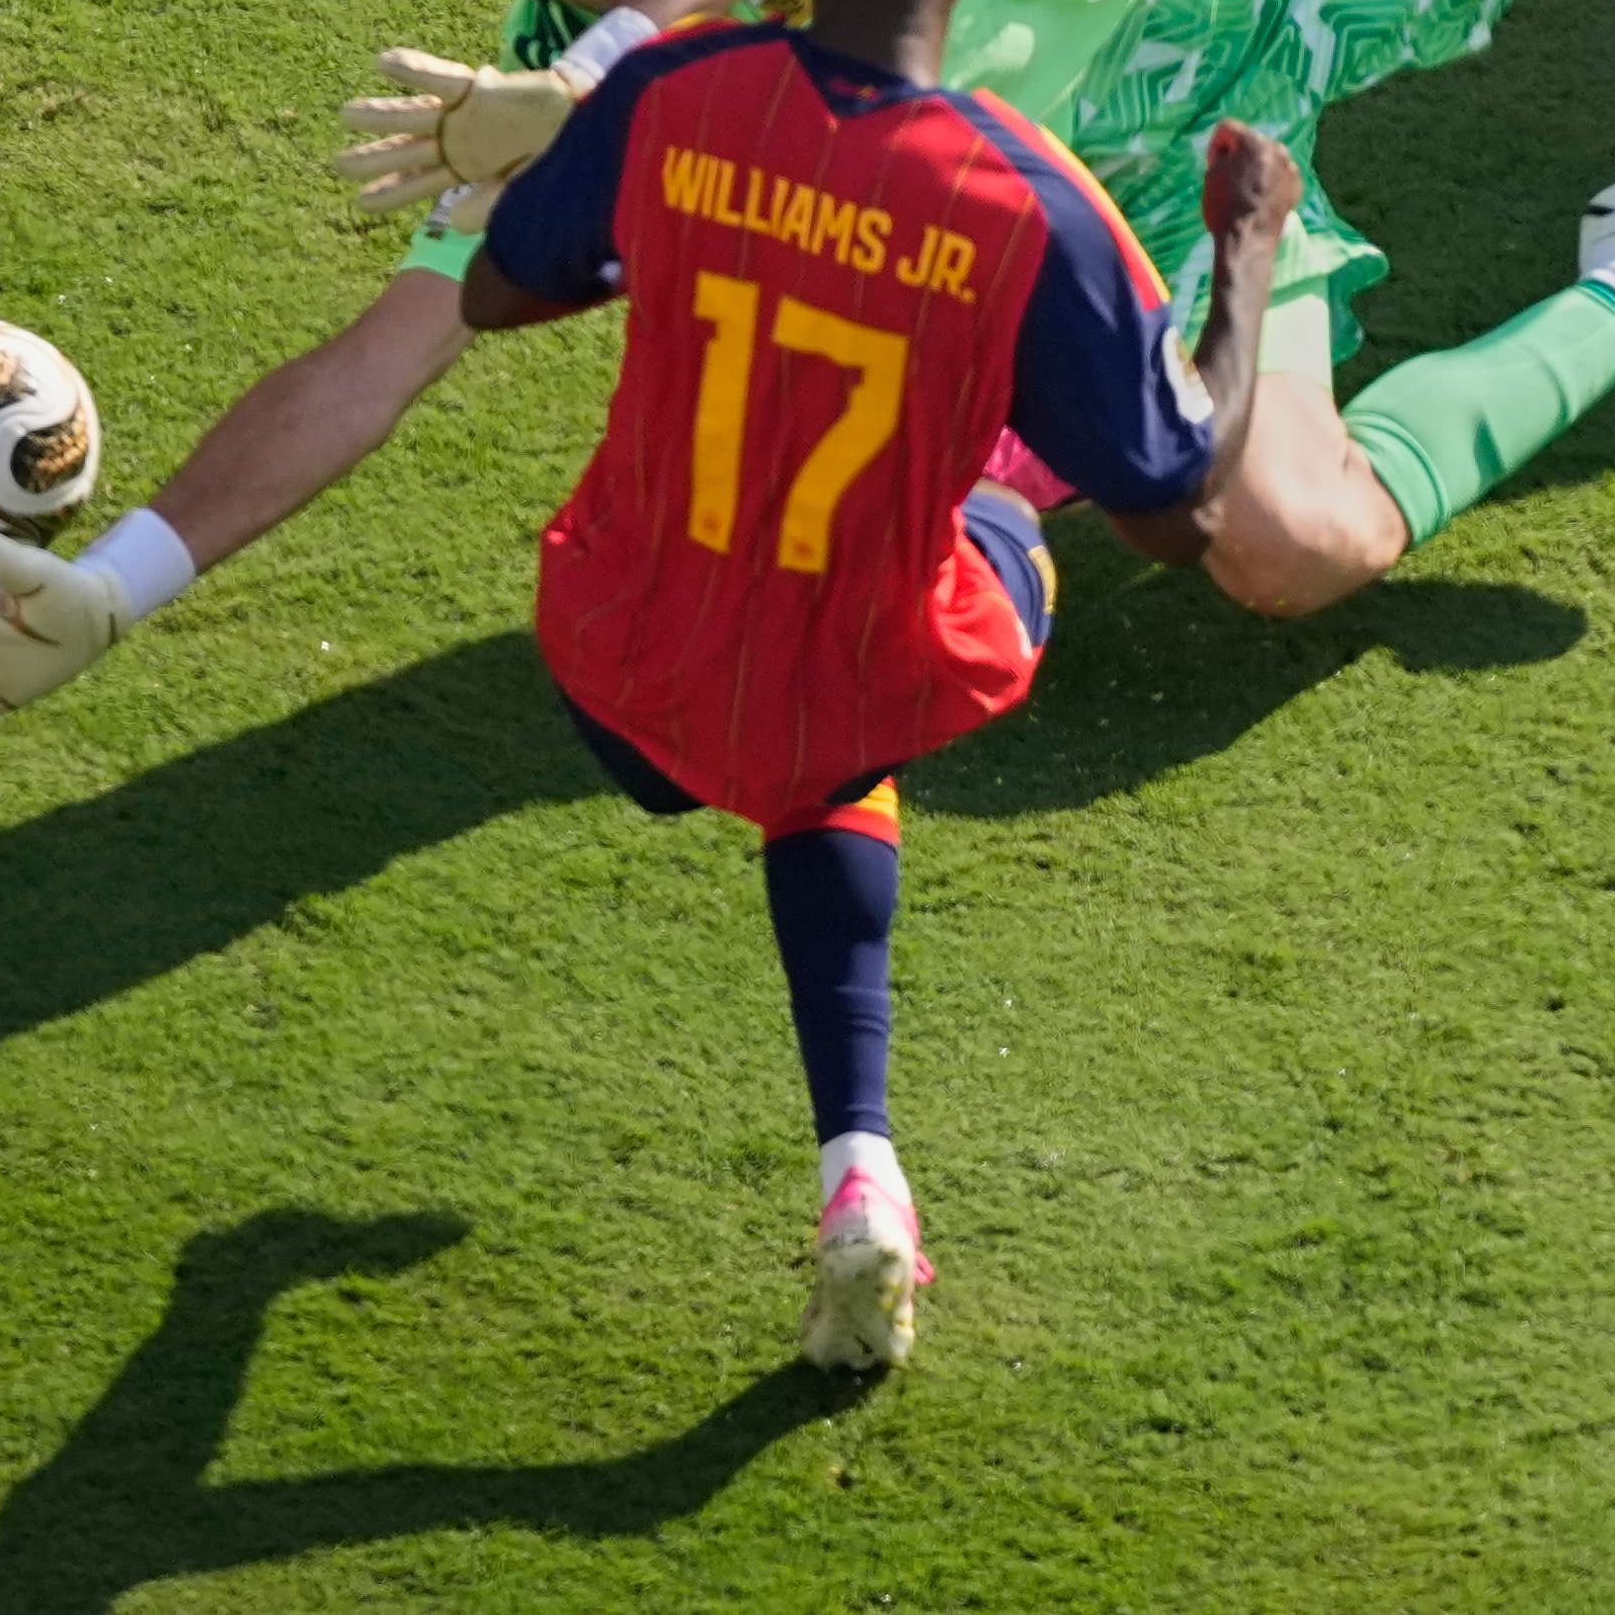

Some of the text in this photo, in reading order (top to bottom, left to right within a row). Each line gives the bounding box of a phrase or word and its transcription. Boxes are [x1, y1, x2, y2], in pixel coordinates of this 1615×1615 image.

[662, 144, 976, 305] WILLIAMS JR.
[688, 269, 910, 574] 17
